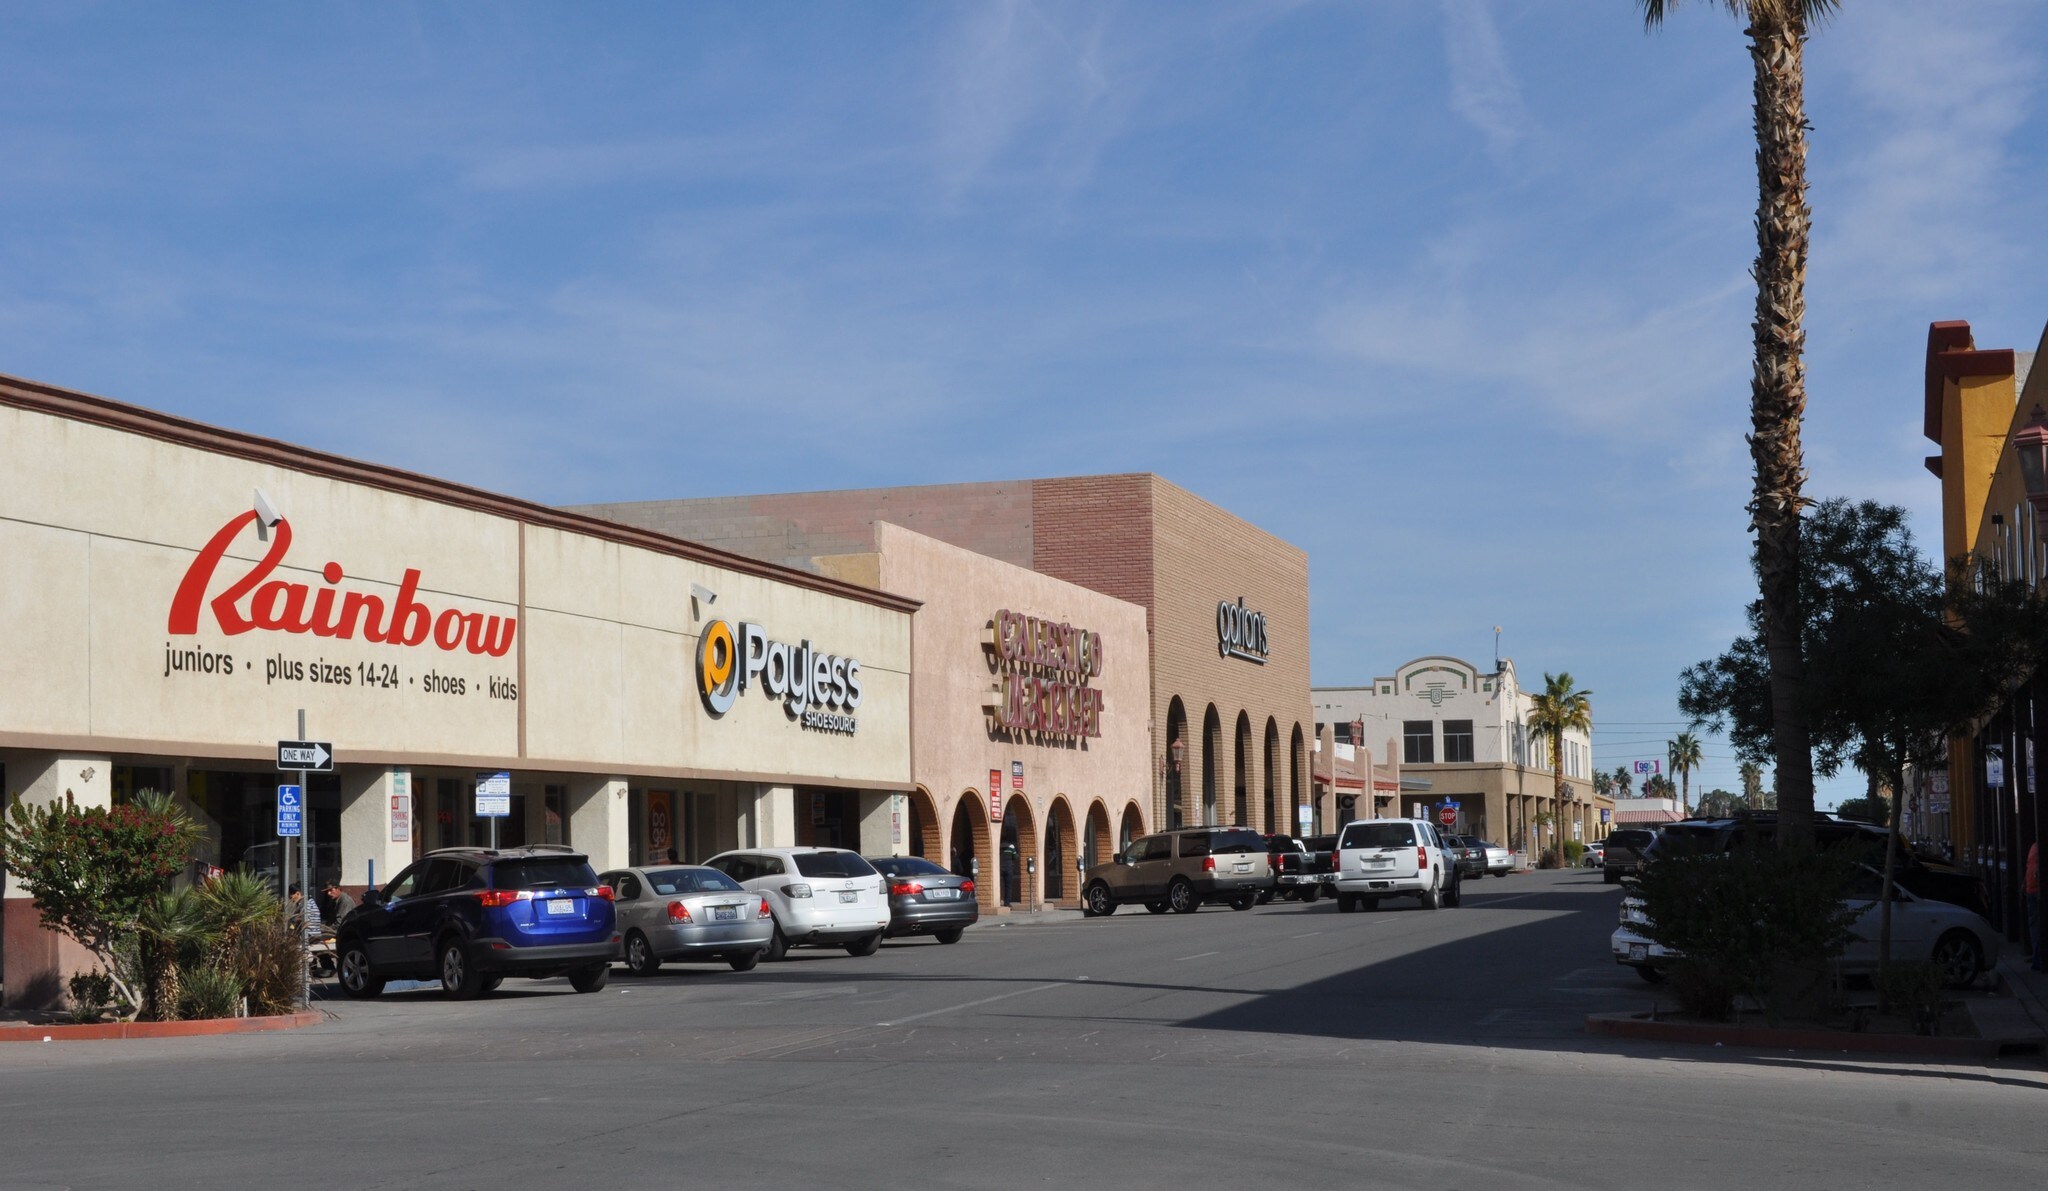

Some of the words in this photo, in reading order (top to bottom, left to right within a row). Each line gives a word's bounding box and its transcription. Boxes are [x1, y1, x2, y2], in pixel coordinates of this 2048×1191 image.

[168, 508, 516, 657] Rainbow
[164, 642, 233, 677] juniors
[266, 653, 304, 685] plus
[309, 657, 352, 685] sizes
[357, 661, 399, 689] 14-24
[423, 669, 466, 696] shoes
[489, 675, 517, 700] kids
[742, 622, 863, 715] Payless
[996, 609, 1102, 678] CALEXICO
[999, 673, 1104, 738] MARKET
[283, 749, 297, 760] ONE
[300, 751, 315, 761] WAY
[283, 813, 297, 821] ONLY
